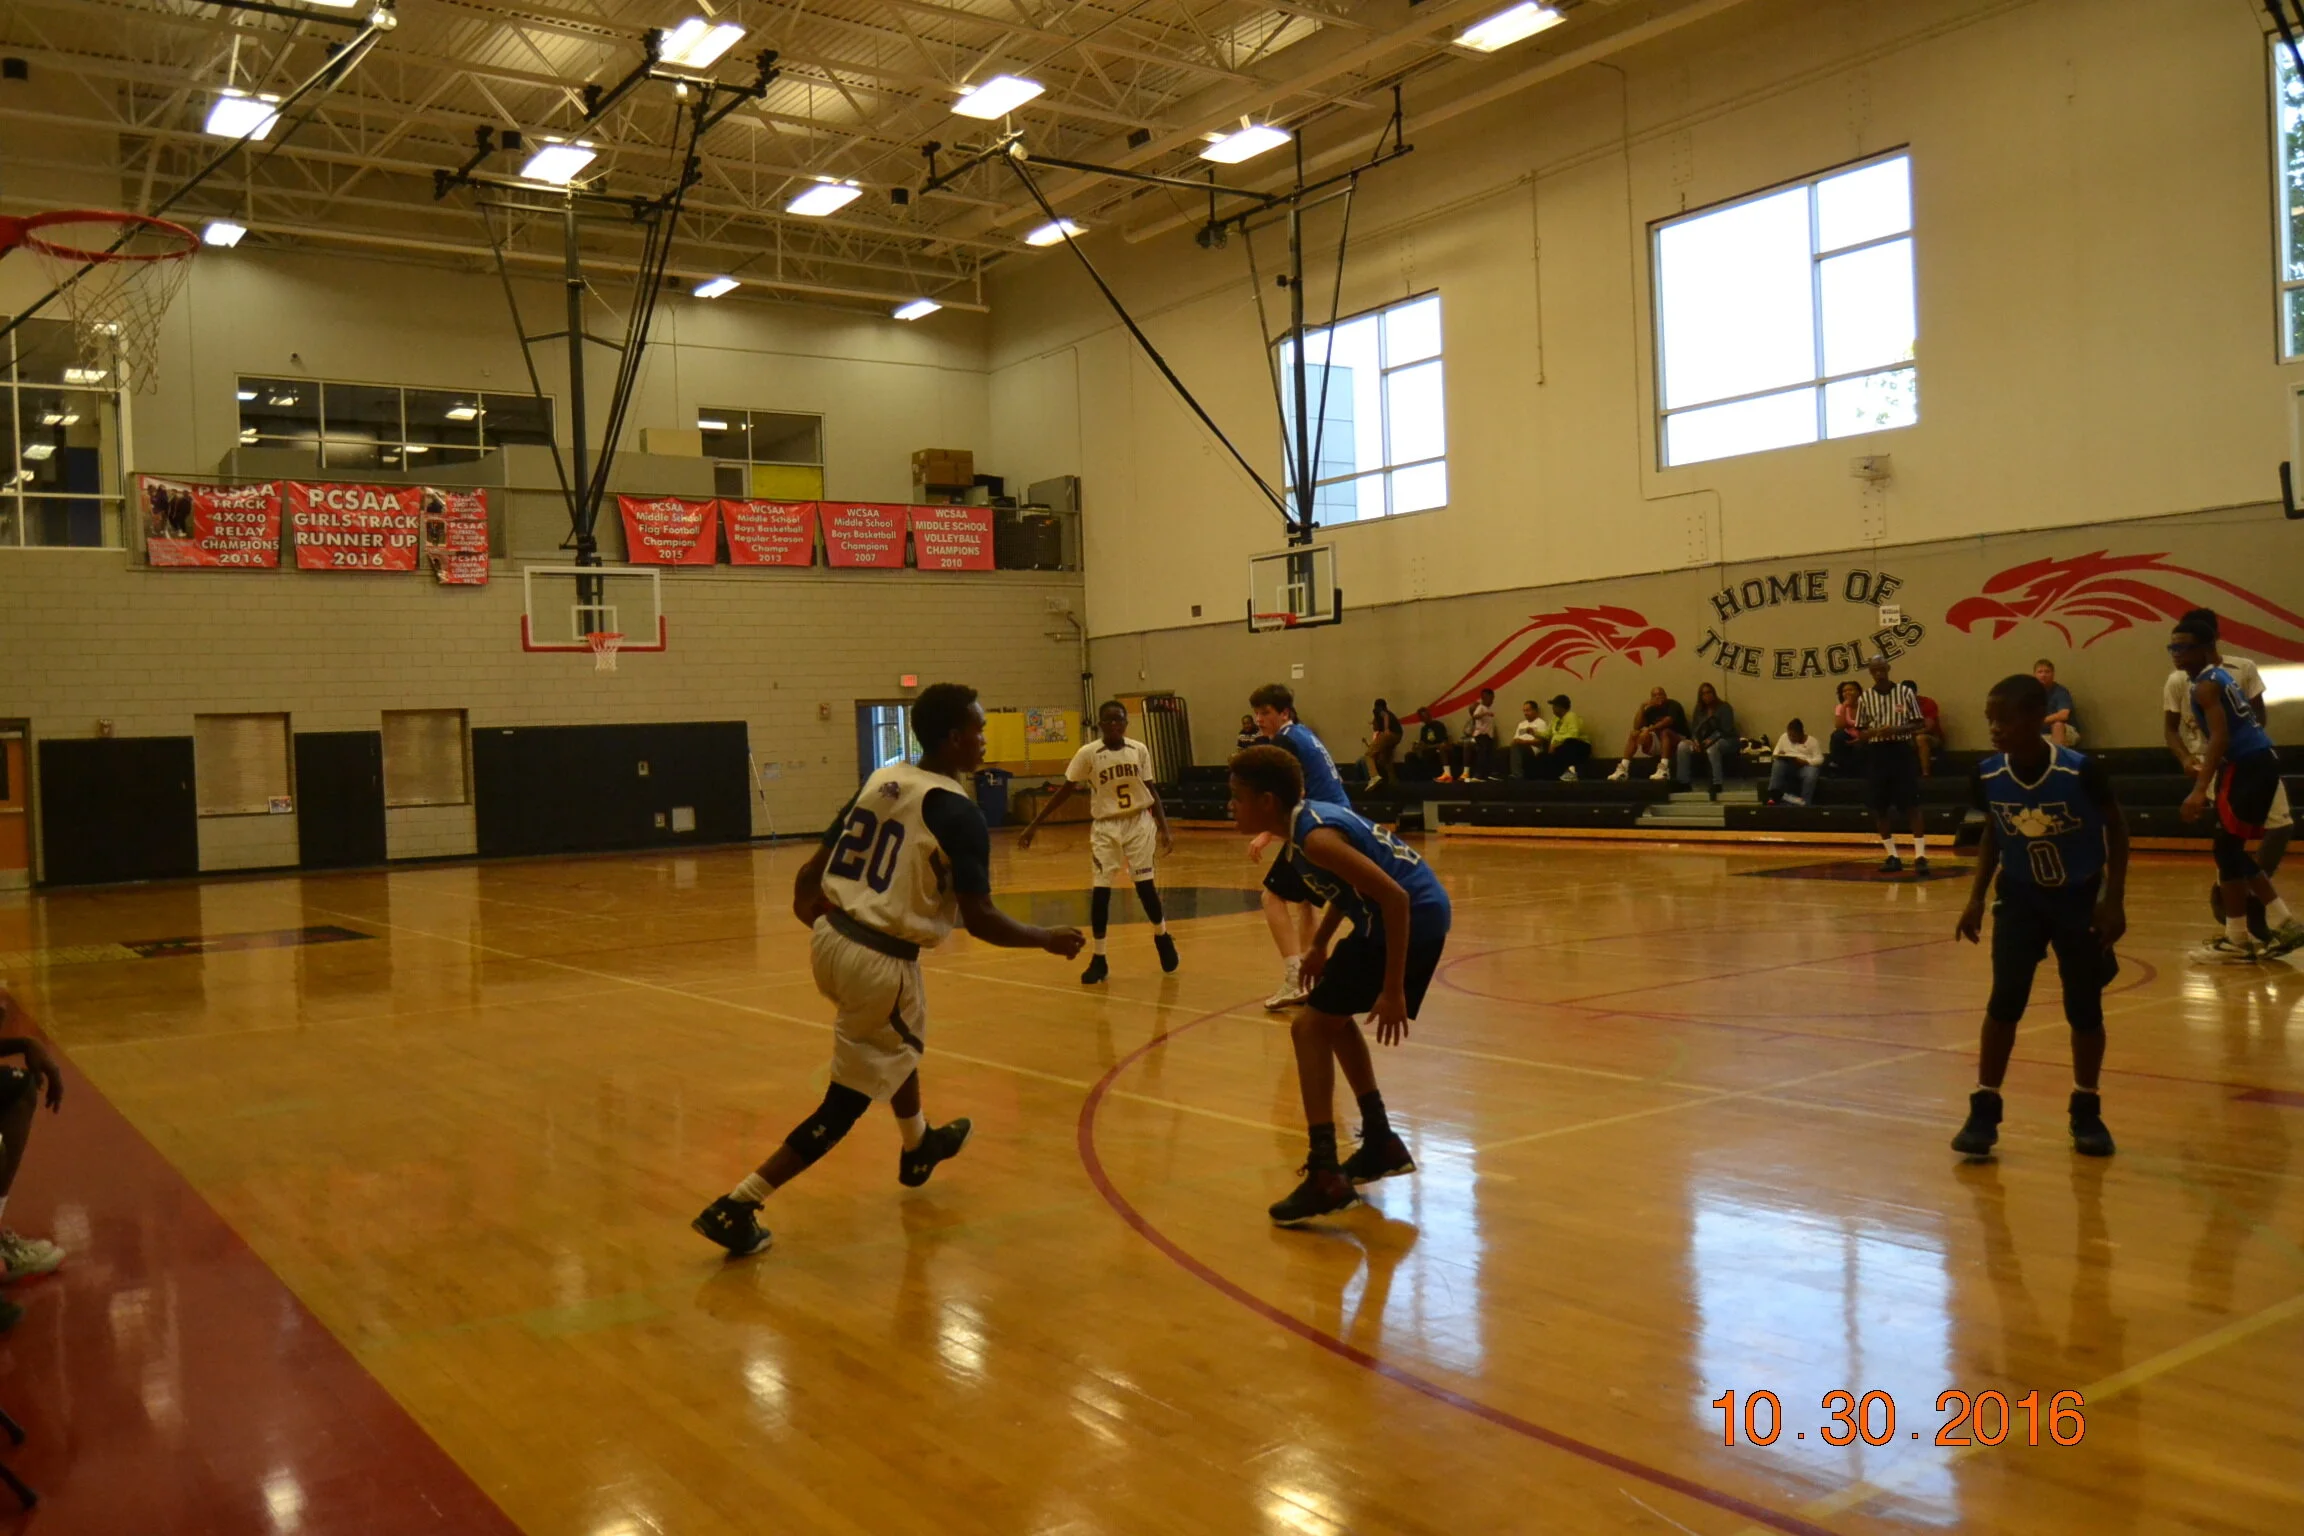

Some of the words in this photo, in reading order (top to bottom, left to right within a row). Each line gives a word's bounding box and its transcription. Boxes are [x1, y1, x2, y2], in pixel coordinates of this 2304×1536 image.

[211, 499, 266, 509] TRACK
[308, 488, 401, 511] PCSAA
[652, 502, 684, 512] PCSAA
[750, 504, 785, 515] WCSAA
[212, 512, 266, 523] 4X200
[636, 512, 669, 521] Middle
[672, 513, 702, 522] School
[846, 508, 880, 517] WCSAA
[935, 509, 968, 519] WCSAA
[294, 513, 352, 527] GIRLS
[357, 515, 419, 529] TRACK
[737, 514, 768, 522] Middle
[771, 515, 800, 523] School
[834, 518, 863, 527] Middle
[865, 519, 893, 528] School
[214, 525, 266, 536] RELAY
[638, 524, 660, 535] Flag
[663, 525, 700, 535] Football
[734, 524, 755, 533] Boys
[758, 525, 803, 533] Basketball
[915, 520, 950, 530] MIDDLE
[952, 522, 988, 532] SCHOOL
[296, 532, 384, 547] RUNNER
[390, 534, 418, 547] UP
[734, 534, 770, 543] Regular
[772, 534, 804, 543] Season
[831, 530, 852, 539] Boys
[853, 530, 897, 539] Basketball
[924, 533, 981, 543] VOLLEYBALL
[201, 539, 279, 550] CHAMPIONS
[643, 536, 696, 548] Champions
[841, 541, 889, 551] Champions
[751, 544, 788, 553] Champs
[926, 546, 980, 556] CHAMPIONS
[219, 553, 262, 564] 2016
[333, 552, 384, 566] 2016
[659, 550, 684, 559] 2015
[855, 553, 876, 562] 2007
[941, 558, 963, 568] 2010
[1710, 569, 1828, 623] HOME
[1843, 568, 1903, 606] OF
[1695, 626, 1764, 677] THE
[1772, 615, 1926, 680] EAGLES
[1116, 784, 1132, 809] 5
[827, 806, 905, 894] 20
[2026, 840, 2066, 887] 0
